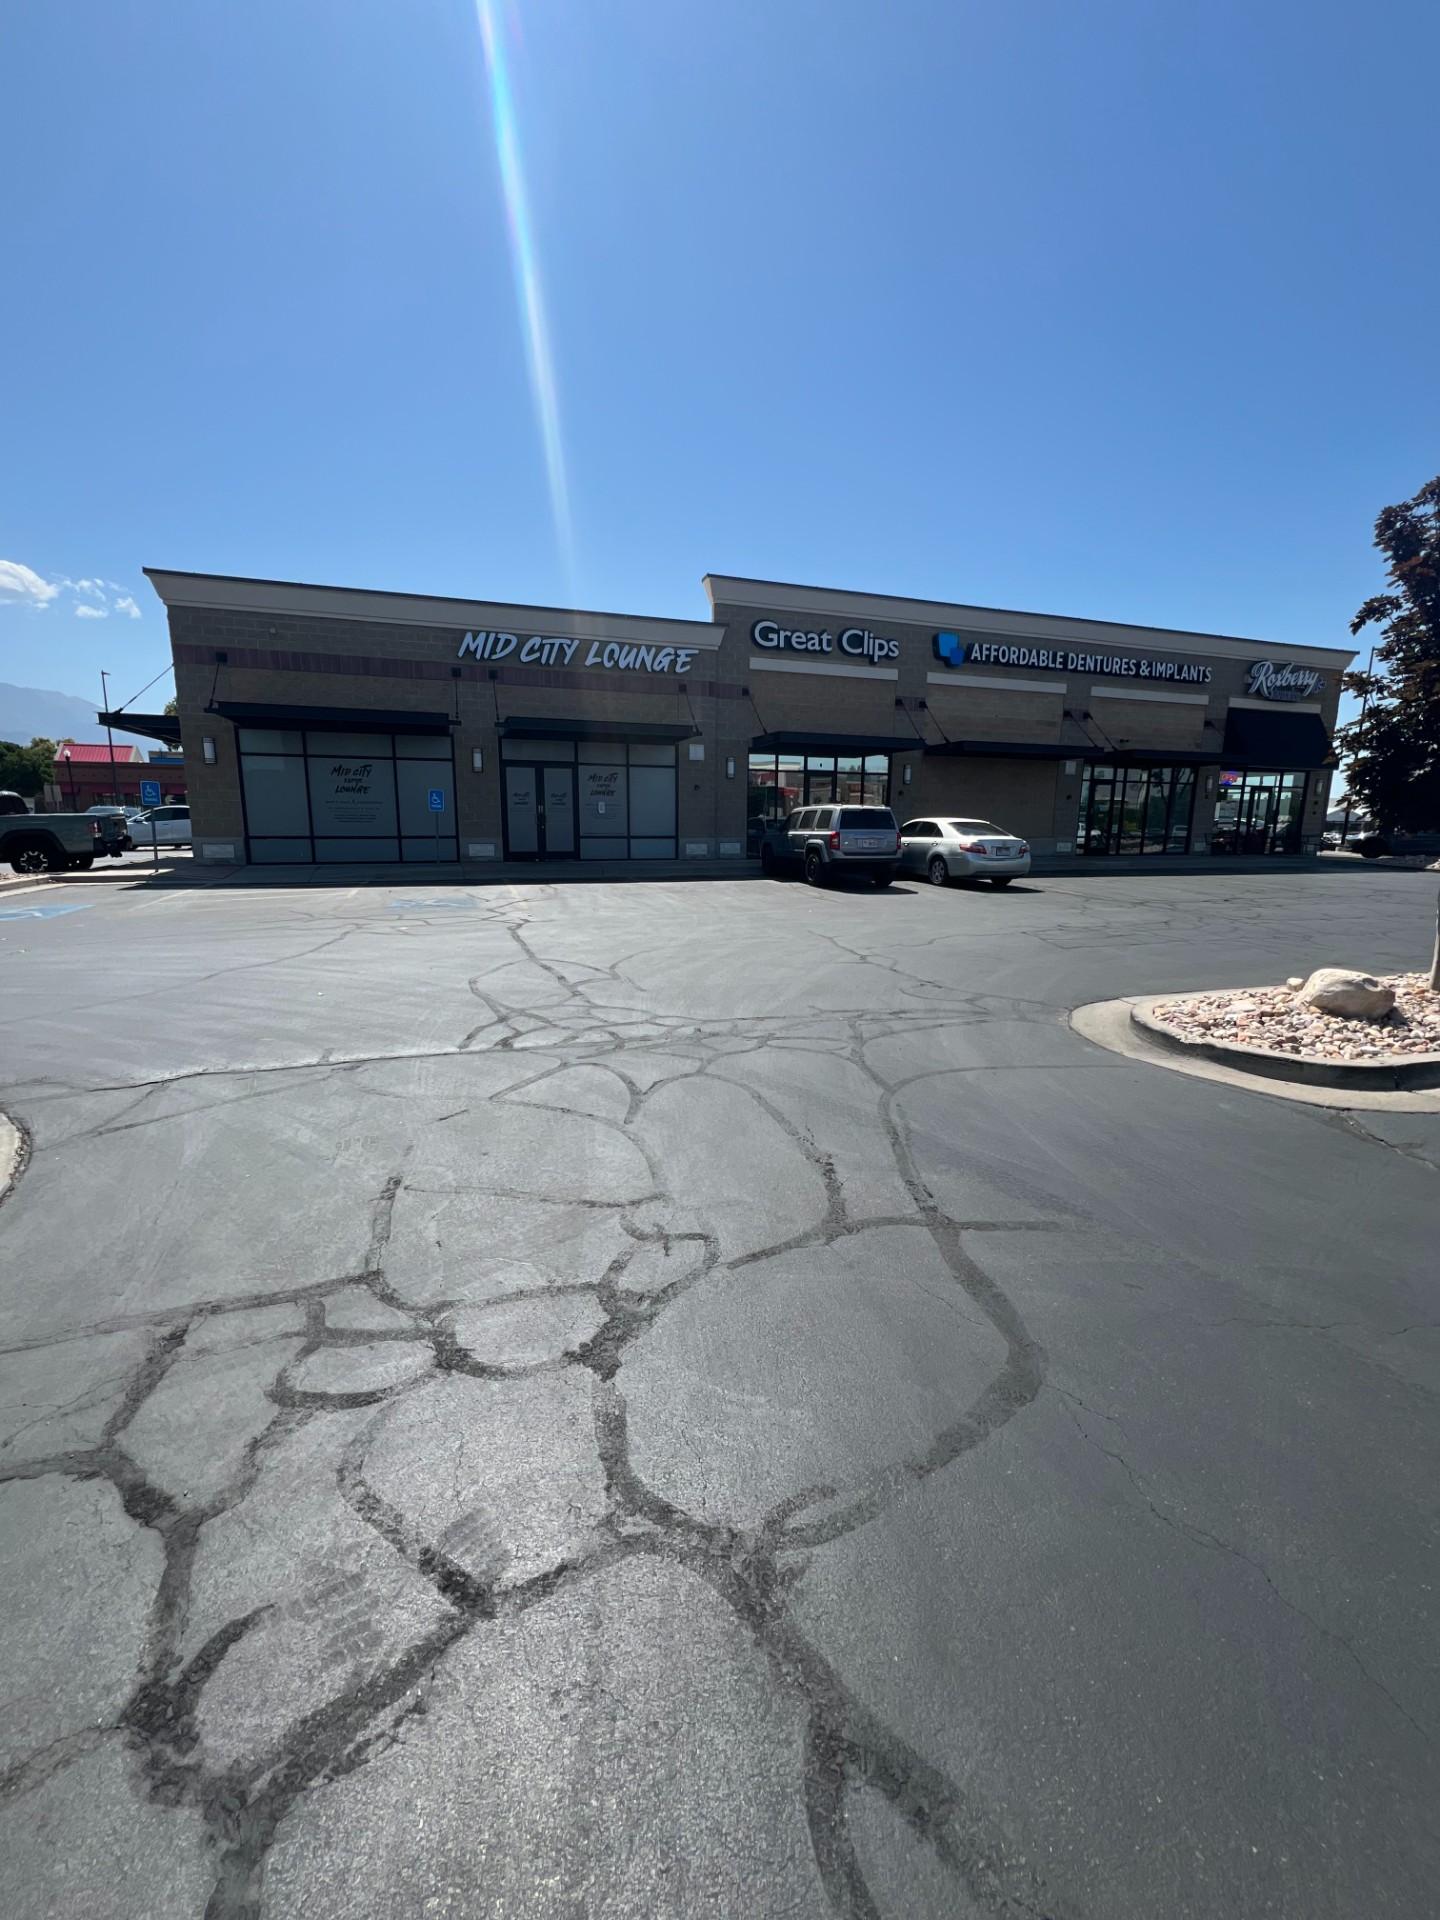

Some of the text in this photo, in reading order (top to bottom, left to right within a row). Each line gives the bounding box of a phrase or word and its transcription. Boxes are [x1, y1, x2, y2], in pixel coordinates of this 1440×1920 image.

[457, 632, 699, 673] MID CITY LOUNGE
[754, 621, 899, 662] Great Clips
[970, 643, 1212, 682] AFFORDABLE DENTURES & IMPLANTS
[1247, 661, 1319, 697] Roxberry
